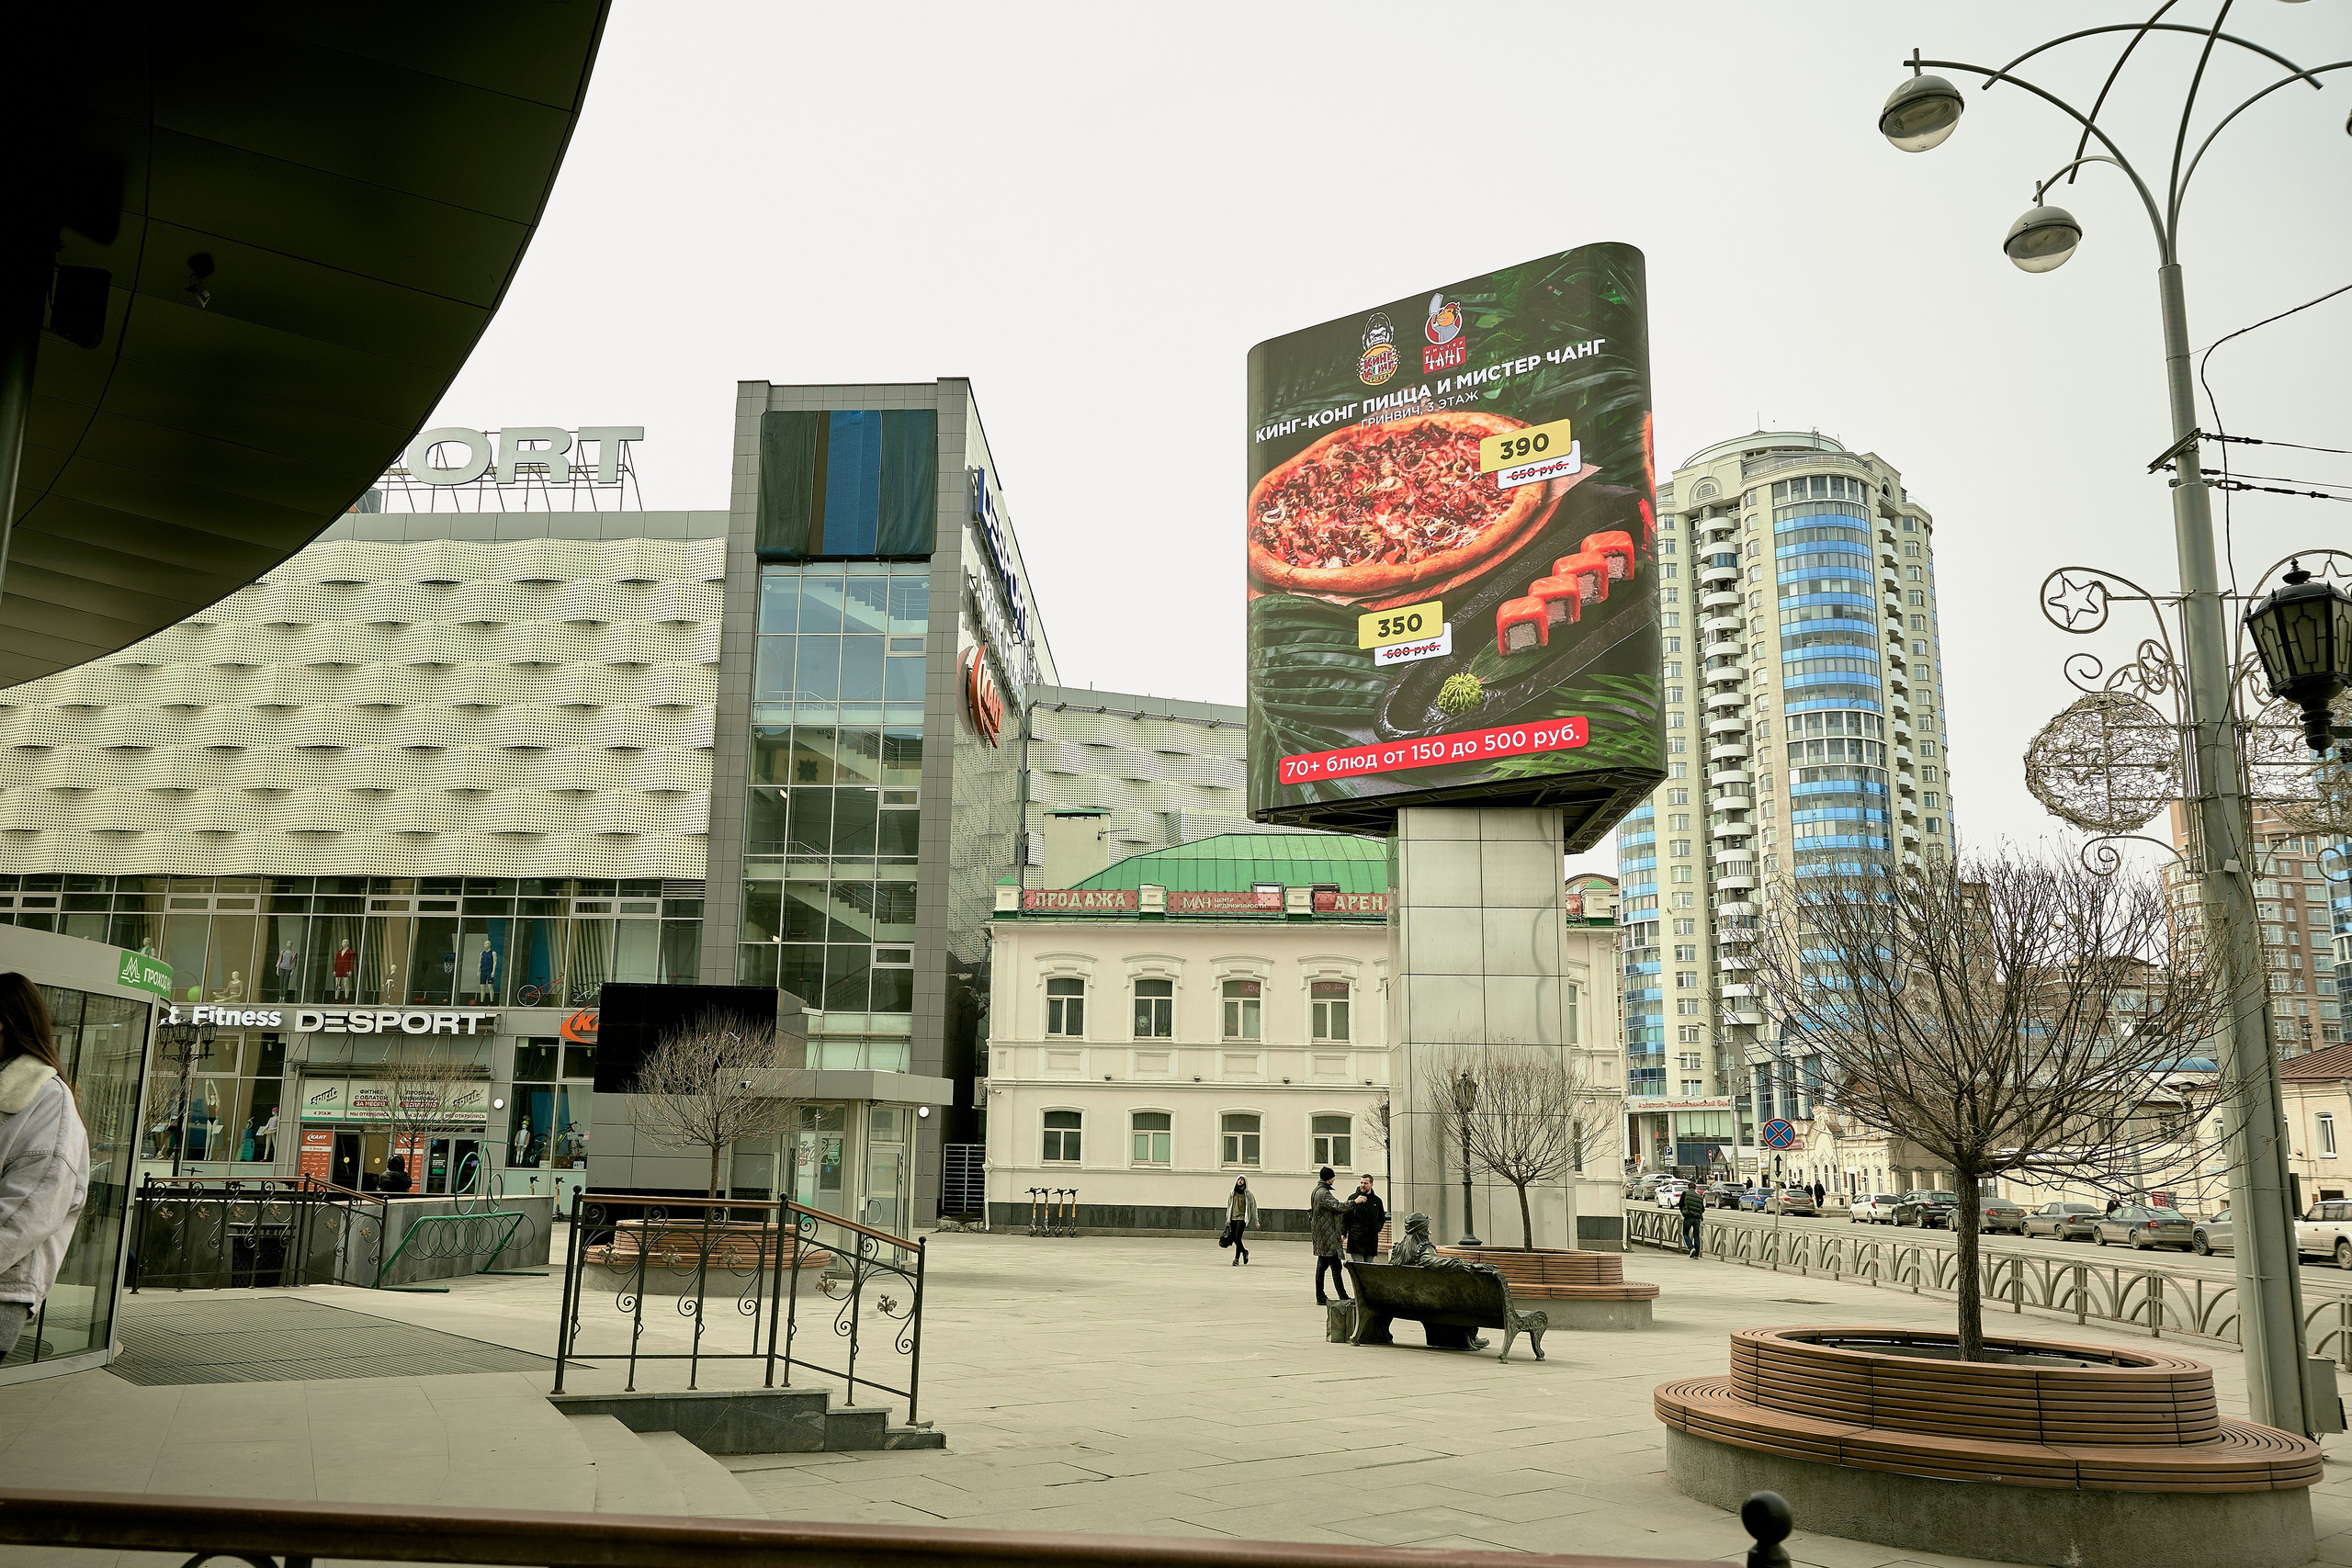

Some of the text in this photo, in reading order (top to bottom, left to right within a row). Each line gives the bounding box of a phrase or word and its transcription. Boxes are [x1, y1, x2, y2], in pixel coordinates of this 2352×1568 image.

[1425, 341, 1464, 355] МИСТЕР
[1425, 346, 1464, 370] ЧАНГ
[1255, 339, 1606, 444] КИНГ-КОНГ ПИЦЦА И МИСТЕР ЧАНГ
[1361, 389, 1479, 430] ГРИНВИЧ, 3 ЭТАЖ
[405, 426, 644, 486] ORT
[1500, 433, 1549, 460] 390
[1511, 461, 1567, 480] 650 руб.
[1377, 613, 1423, 637] 350
[1386, 642, 1440, 659] 600 руб.
[1285, 723, 1580, 778] 70+ блюд от 150 до 500 руб.
[1035, 892, 1126, 908] ПРОДАЖА
[192, 1006, 283, 1026] Fitness
[294, 1010, 487, 1035] DESPORT
